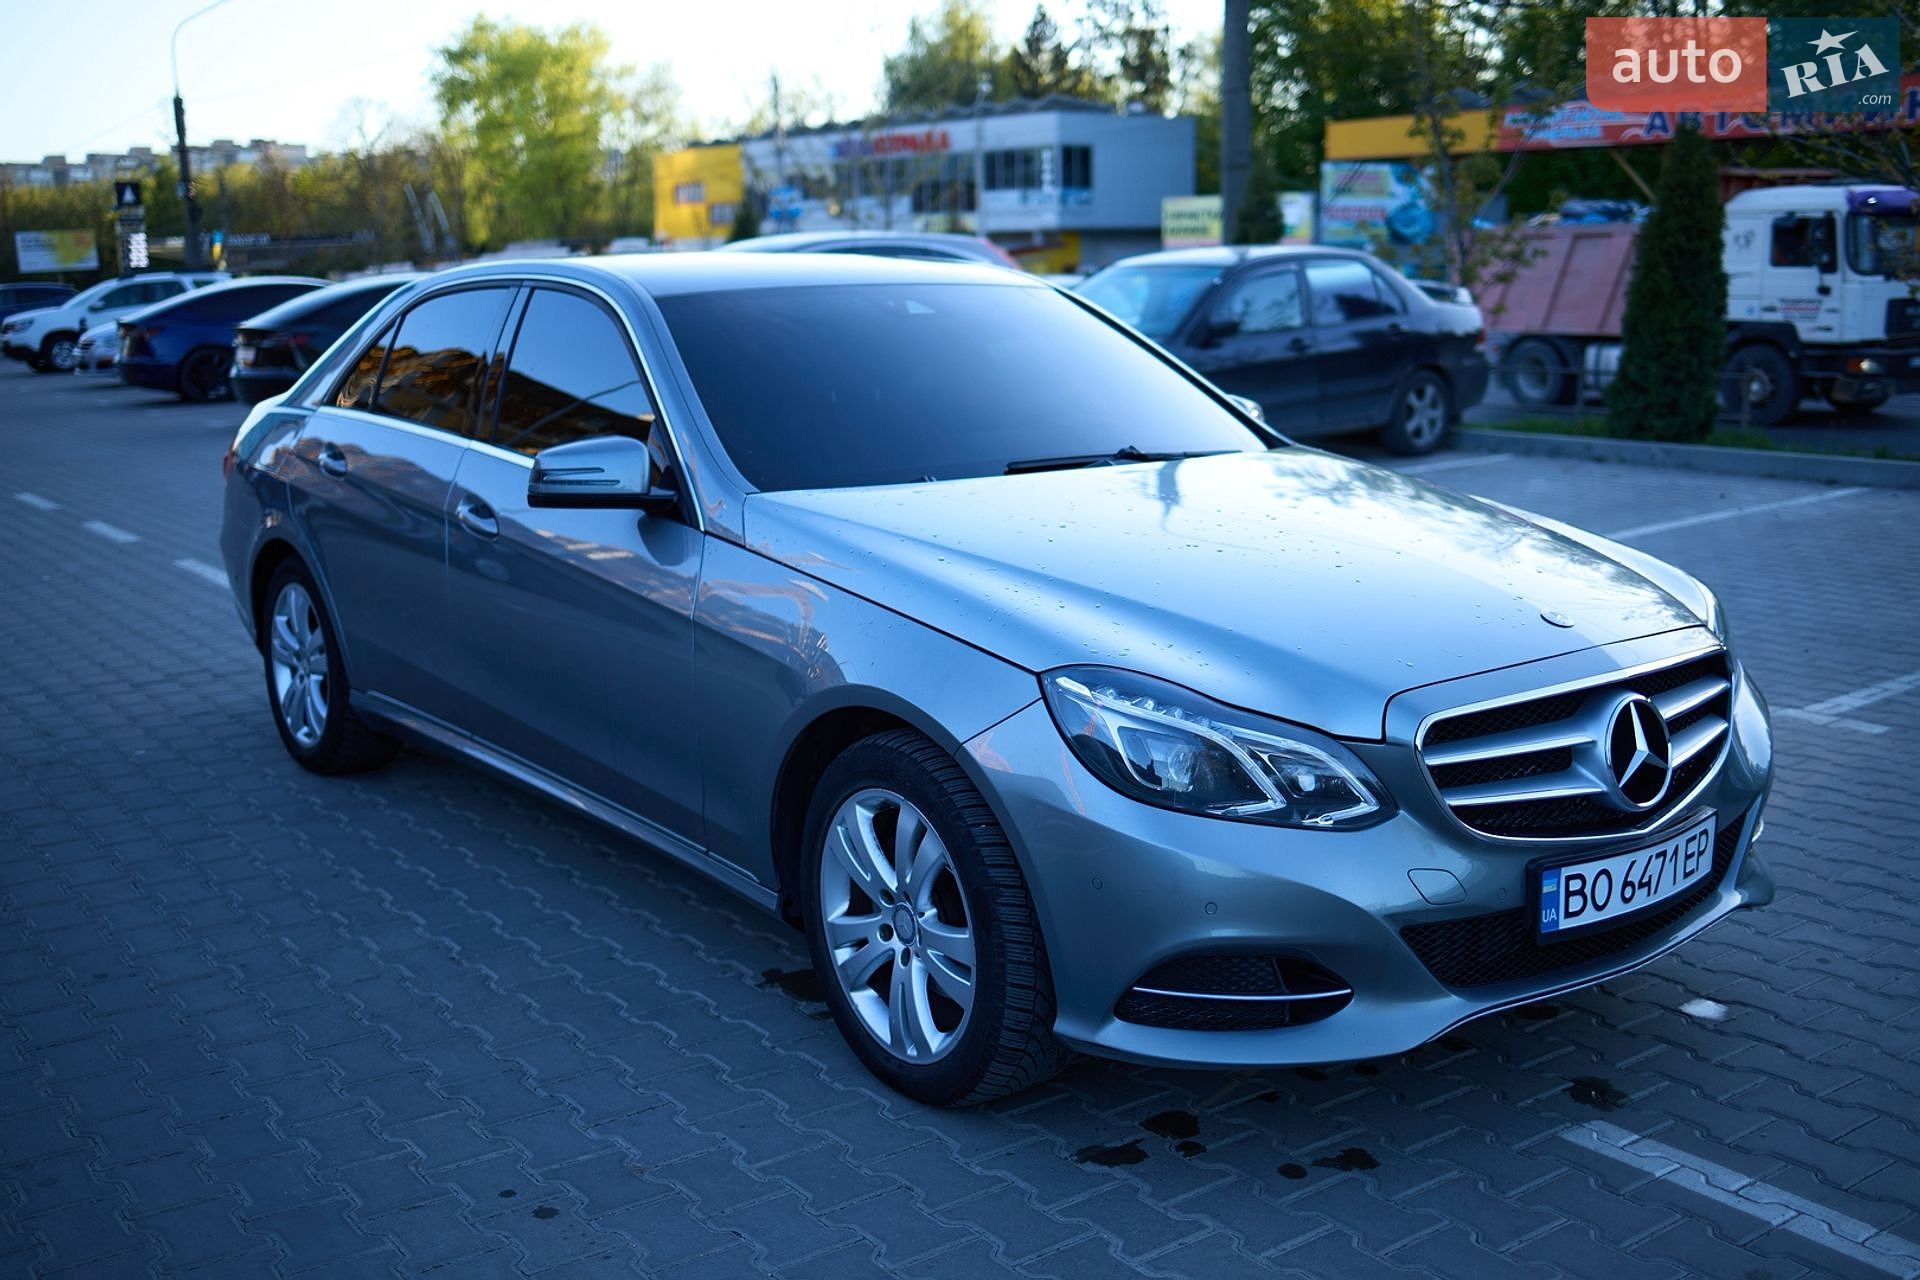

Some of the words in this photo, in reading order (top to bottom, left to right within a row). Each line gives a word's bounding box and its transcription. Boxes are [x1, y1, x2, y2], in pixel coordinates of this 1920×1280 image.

[1563, 868, 1613, 919] BO
[1620, 843, 1680, 904] 6471
[1683, 828, 1709, 879] EP
[1542, 908, 1558, 924] UA
